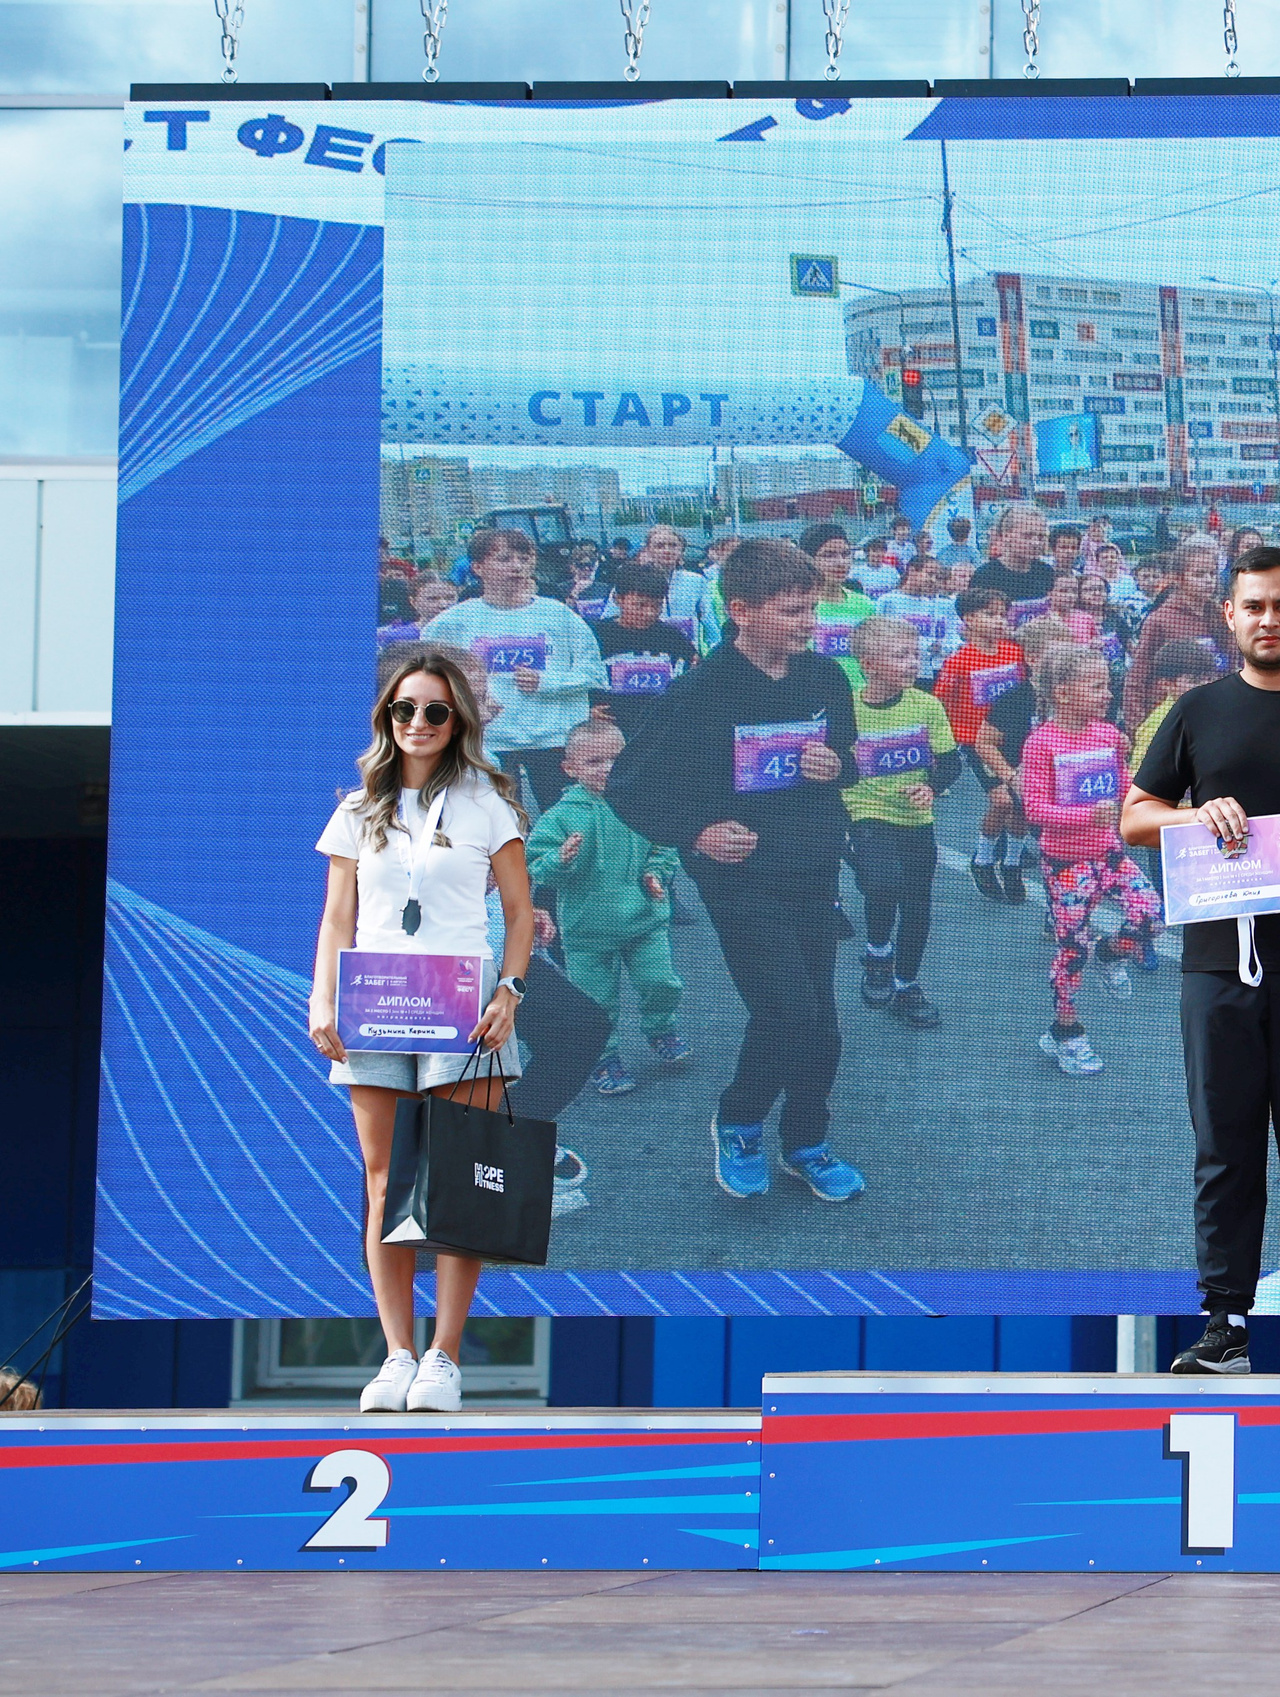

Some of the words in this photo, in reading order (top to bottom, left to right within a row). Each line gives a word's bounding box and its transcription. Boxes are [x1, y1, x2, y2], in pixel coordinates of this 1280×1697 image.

[237, 113, 386, 176] ФЕ
[527, 390, 730, 427] СТАРТ
[493, 648, 535, 667] 475
[627, 673, 663, 688] 423
[879, 747, 921, 768] 450
[1079, 773, 1115, 797] 442
[1209, 859, 1262, 875] ДИПЛОМ
[376, 995, 432, 1008] ДИПЛОМ
[474, 1162, 505, 1184] HOPE
[474, 1177, 505, 1194] FITNESS
[1164, 1413, 1237, 1554] 1
[298, 1448, 392, 1552] 2
